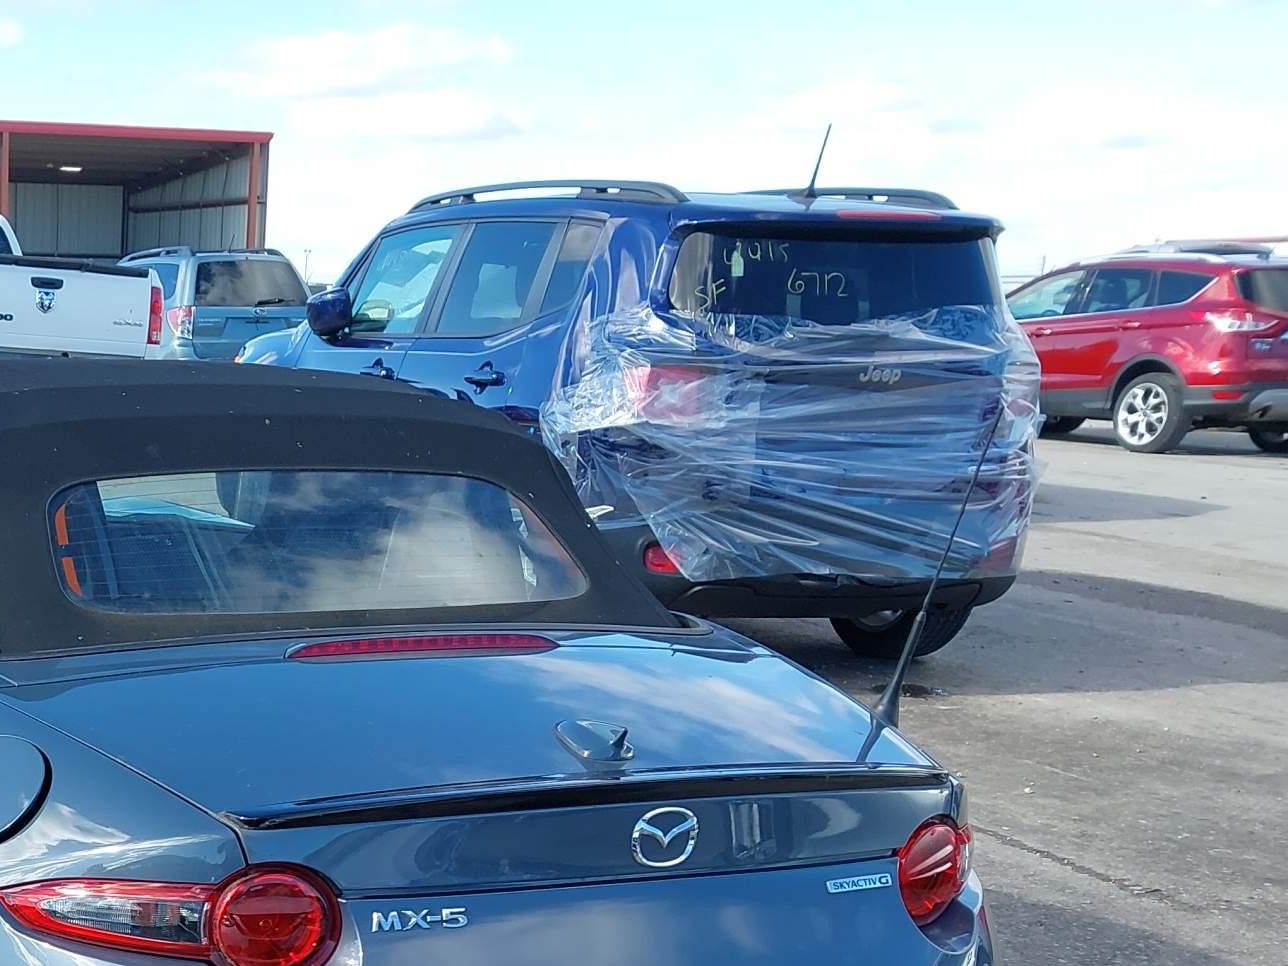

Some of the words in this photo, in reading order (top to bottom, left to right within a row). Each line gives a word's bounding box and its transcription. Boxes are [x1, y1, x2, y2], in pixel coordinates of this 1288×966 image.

[787, 268, 848, 297] 6712
[859, 365, 902, 385] Jeep
[371, 907, 469, 932] MX-5
